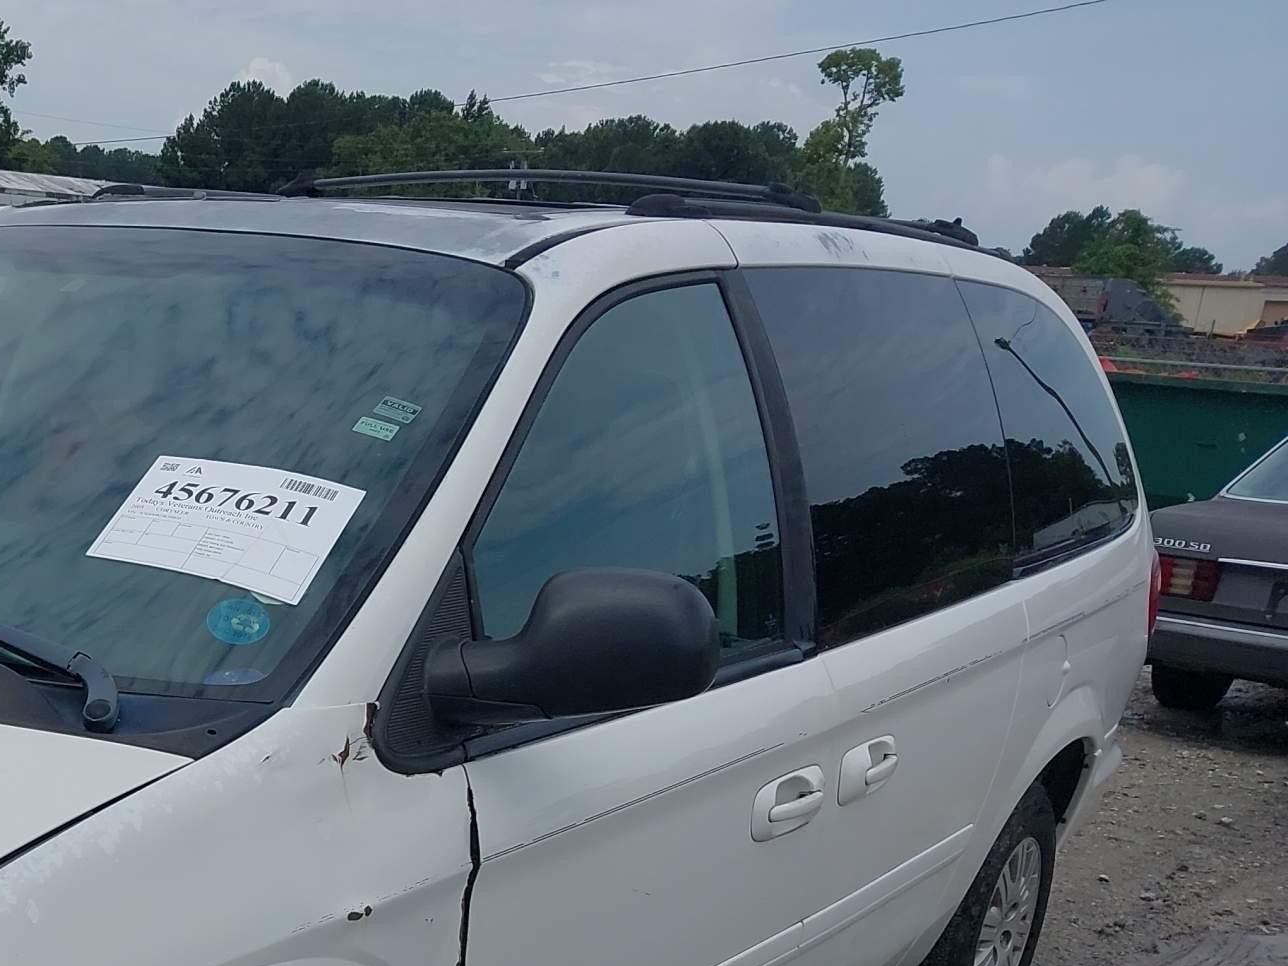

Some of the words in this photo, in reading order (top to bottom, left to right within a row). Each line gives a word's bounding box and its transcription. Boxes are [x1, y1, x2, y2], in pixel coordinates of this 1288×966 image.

[154, 480, 319, 528] 45676211
[168, 500, 202, 511] Veterans
[204, 505, 243, 518] Outreach
[1153, 537, 1186, 548] 300
[1189, 541, 1211, 552] SD
